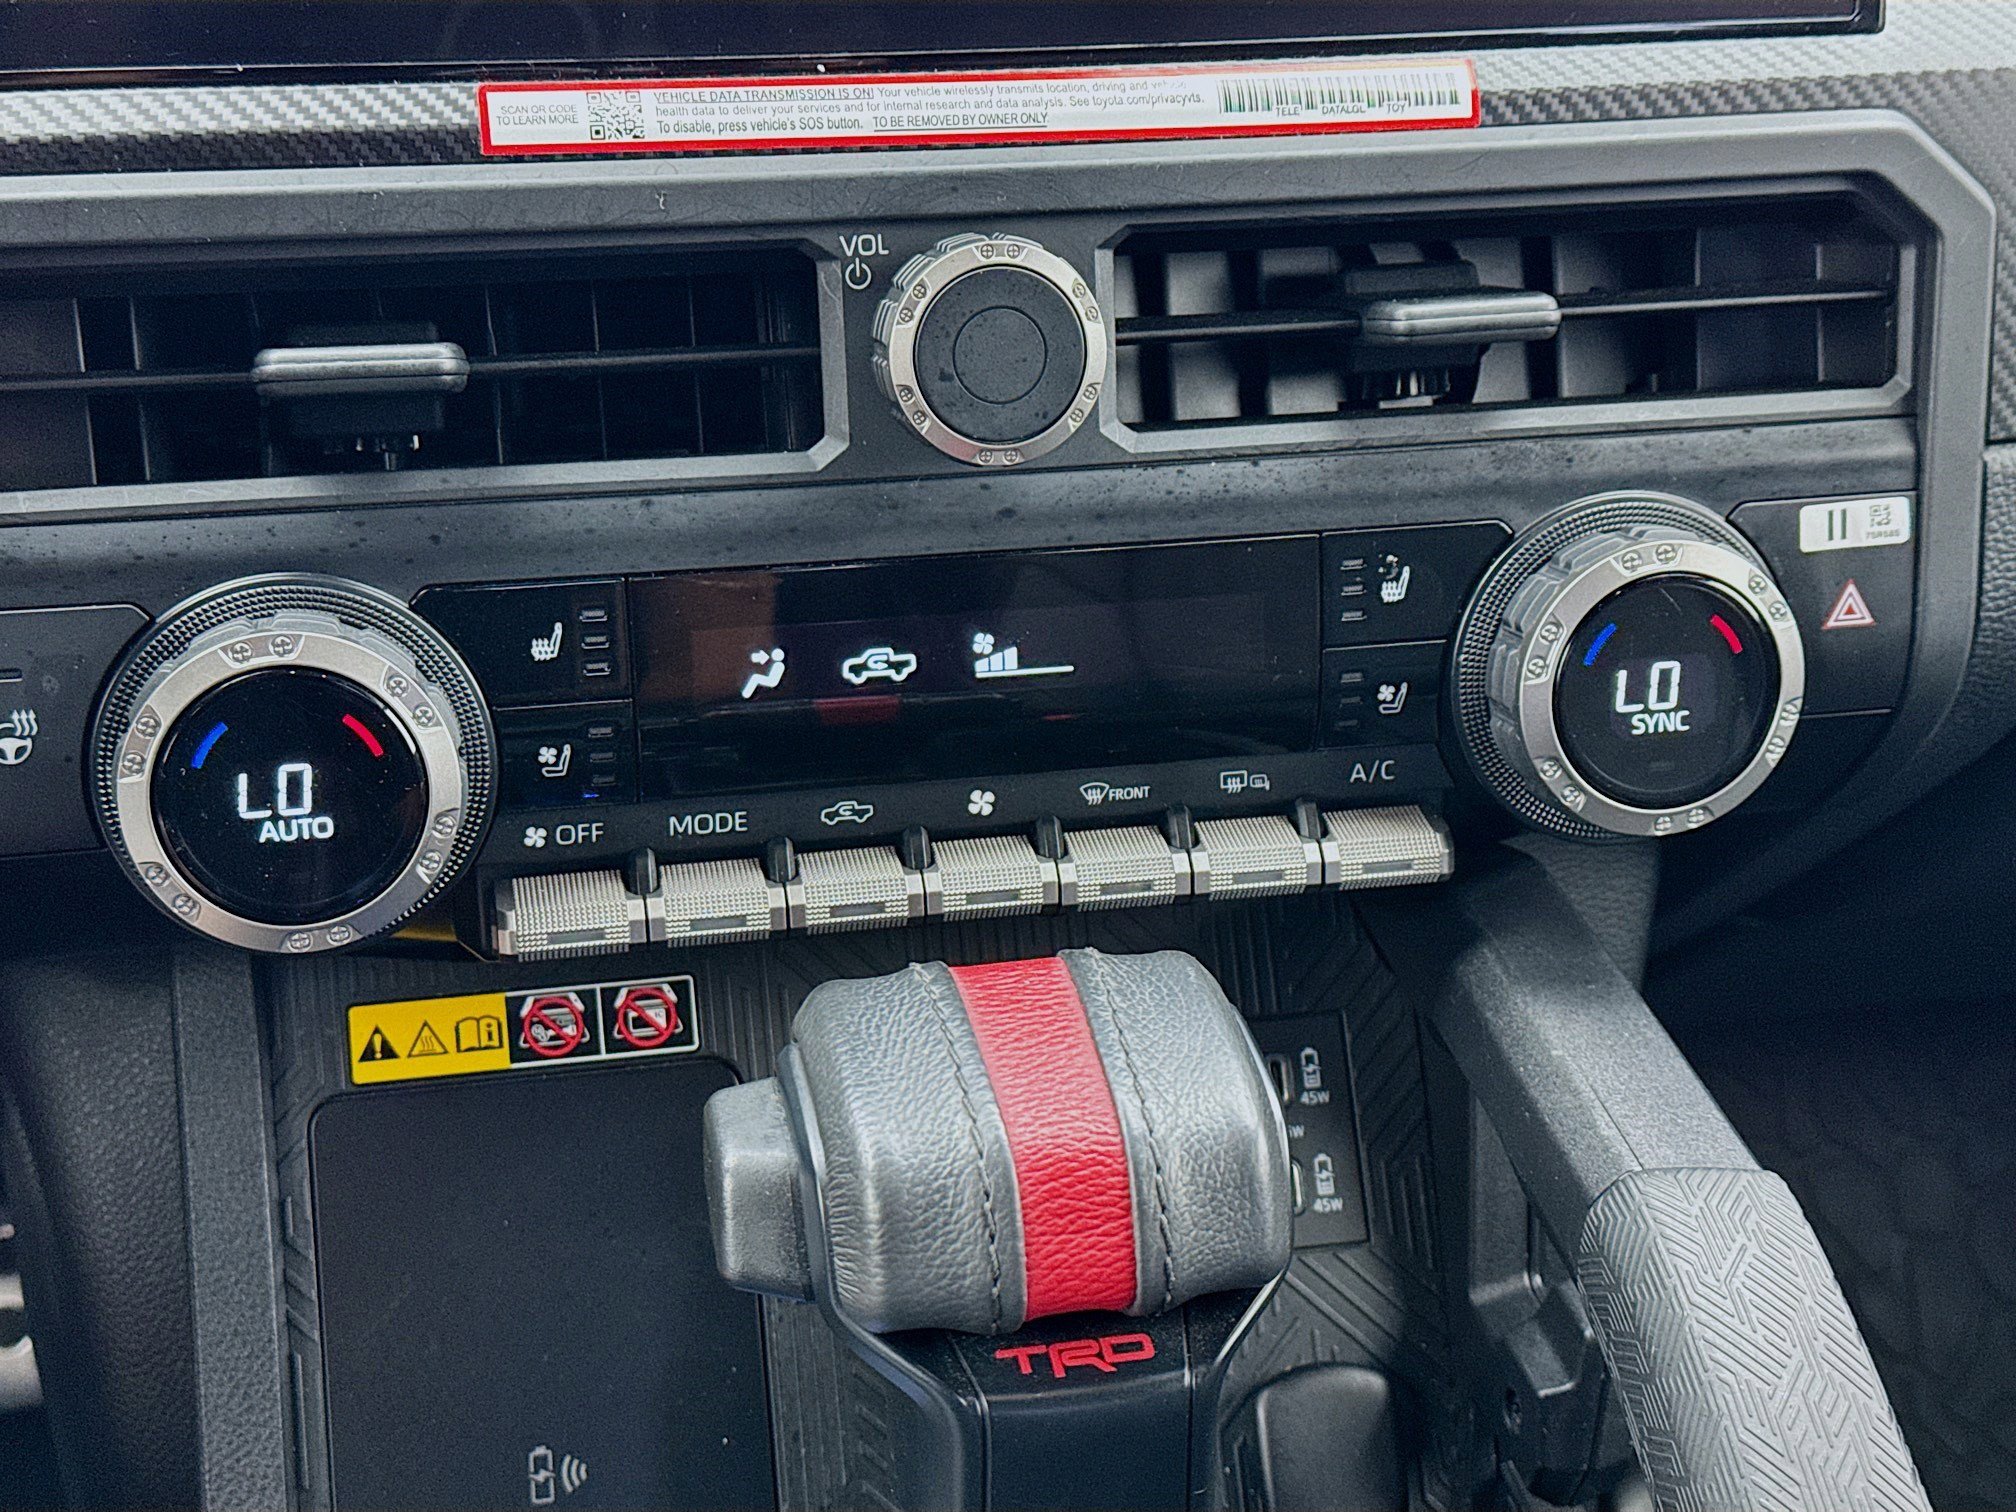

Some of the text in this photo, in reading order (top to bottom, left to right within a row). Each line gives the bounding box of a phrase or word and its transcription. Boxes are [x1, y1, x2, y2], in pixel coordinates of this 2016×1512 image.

[653, 91, 707, 102] VEHICLE
[710, 90, 741, 102] DATA
[744, 88, 835, 102] TRANSMISSION
[839, 88, 850, 99] IS
[853, 87, 874, 99] ON!
[877, 87, 901, 97] Your
[904, 86, 941, 97] vehicle
[944, 85, 994, 97] wirelessly
[996, 83, 1044, 94] transmits
[1047, 82, 1090, 93] location,
[1092, 81, 1126, 93] driving
[1129, 81, 1148, 90] and
[501, 104, 577, 114] SCAN QR CODE
[655, 105, 689, 117] health
[692, 105, 715, 116] data
[718, 106, 729, 115] to
[733, 104, 767, 115] deliver
[771, 105, 794, 117] your
[798, 104, 840, 114] services
[844, 102, 863, 112] and
[867, 102, 880, 111] for
[883, 101, 922, 111] internal
[926, 99, 971, 110] research
[974, 99, 993, 109] and
[996, 98, 1018, 109] data
[1069, 96, 1089, 107] See
[496, 114, 579, 126] TO LEARN MORE
[657, 117, 863, 135] To disable, press vehicle's SOS button.
[873, 117, 887, 128] TO
[890, 116, 904, 127] BE
[907, 114, 960, 127] REMOVED
[962, 114, 976, 125] BY
[978, 113, 1018, 125] OWNER
[839, 234, 889, 256] VOL
[1615, 660, 1681, 713] LO
[1631, 710, 1690, 736] SYNC
[1350, 759, 1395, 783] A/C
[238, 763, 313, 819] LO
[1108, 786, 1150, 801] FRONT
[259, 816, 335, 844] AUTO
[555, 823, 604, 846] OFF
[669, 811, 748, 837] MODE
[1300, 1090, 1330, 1105] 45W
[1313, 1198, 1343, 1213] 45W
[994, 1333, 1155, 1378] TRD
